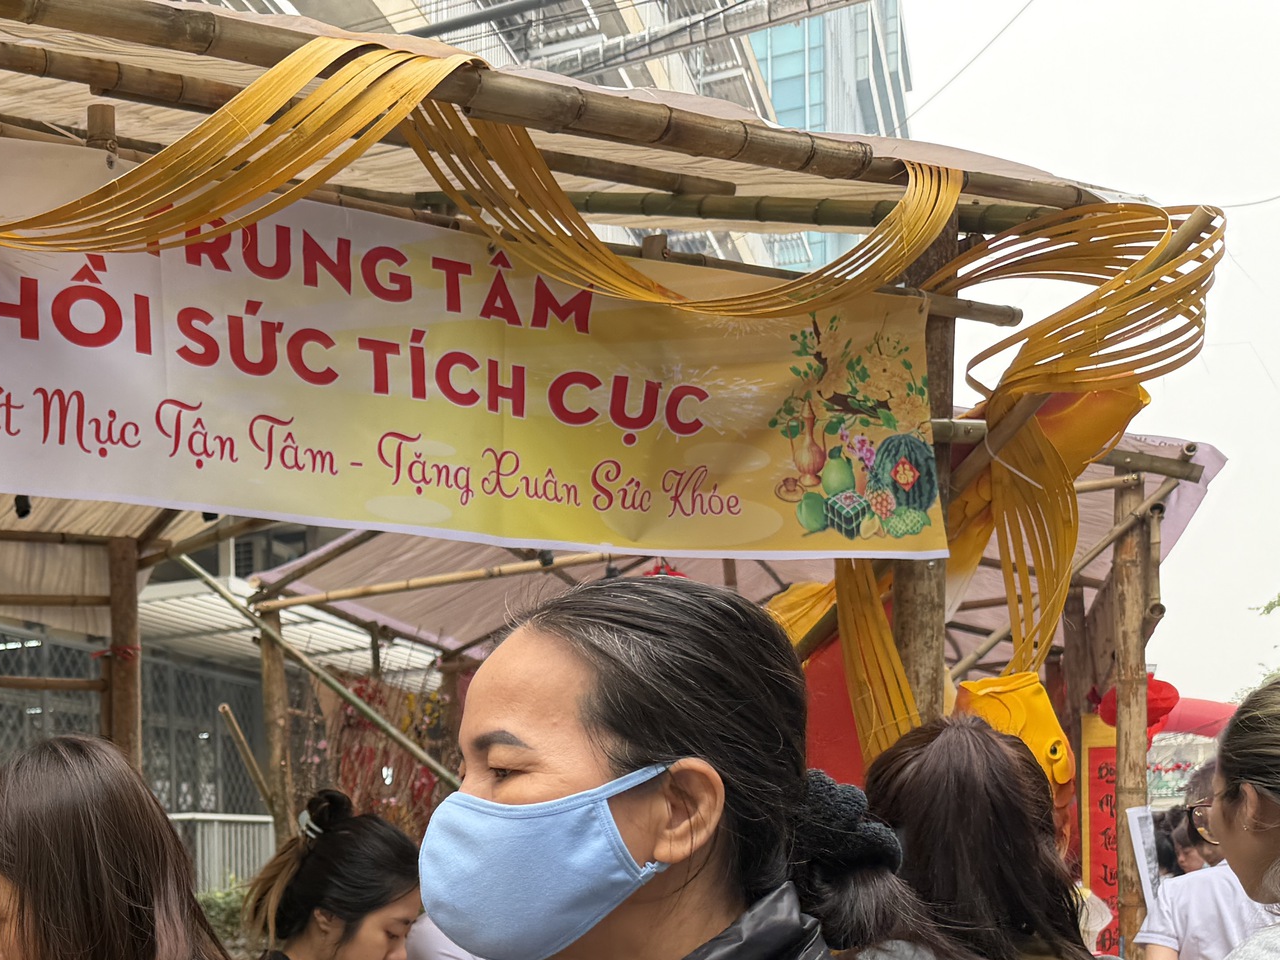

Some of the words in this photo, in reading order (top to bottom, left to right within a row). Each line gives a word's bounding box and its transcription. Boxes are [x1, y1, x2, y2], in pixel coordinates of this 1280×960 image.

[143, 202, 413, 303] RUNG
[431, 250, 595, 335] TÂM
[175, 299, 340, 386] SỨC
[357, 328, 526, 419] TÍCH
[547, 370, 710, 447] CỰC
[32, 387, 142, 458] Mực
[154, 398, 239, 469] Tận
[248, 414, 339, 476] Tâm
[376, 431, 475, 506] Tặng
[481, 448, 582, 507] Xuân
[590, 459, 653, 512] Sức
